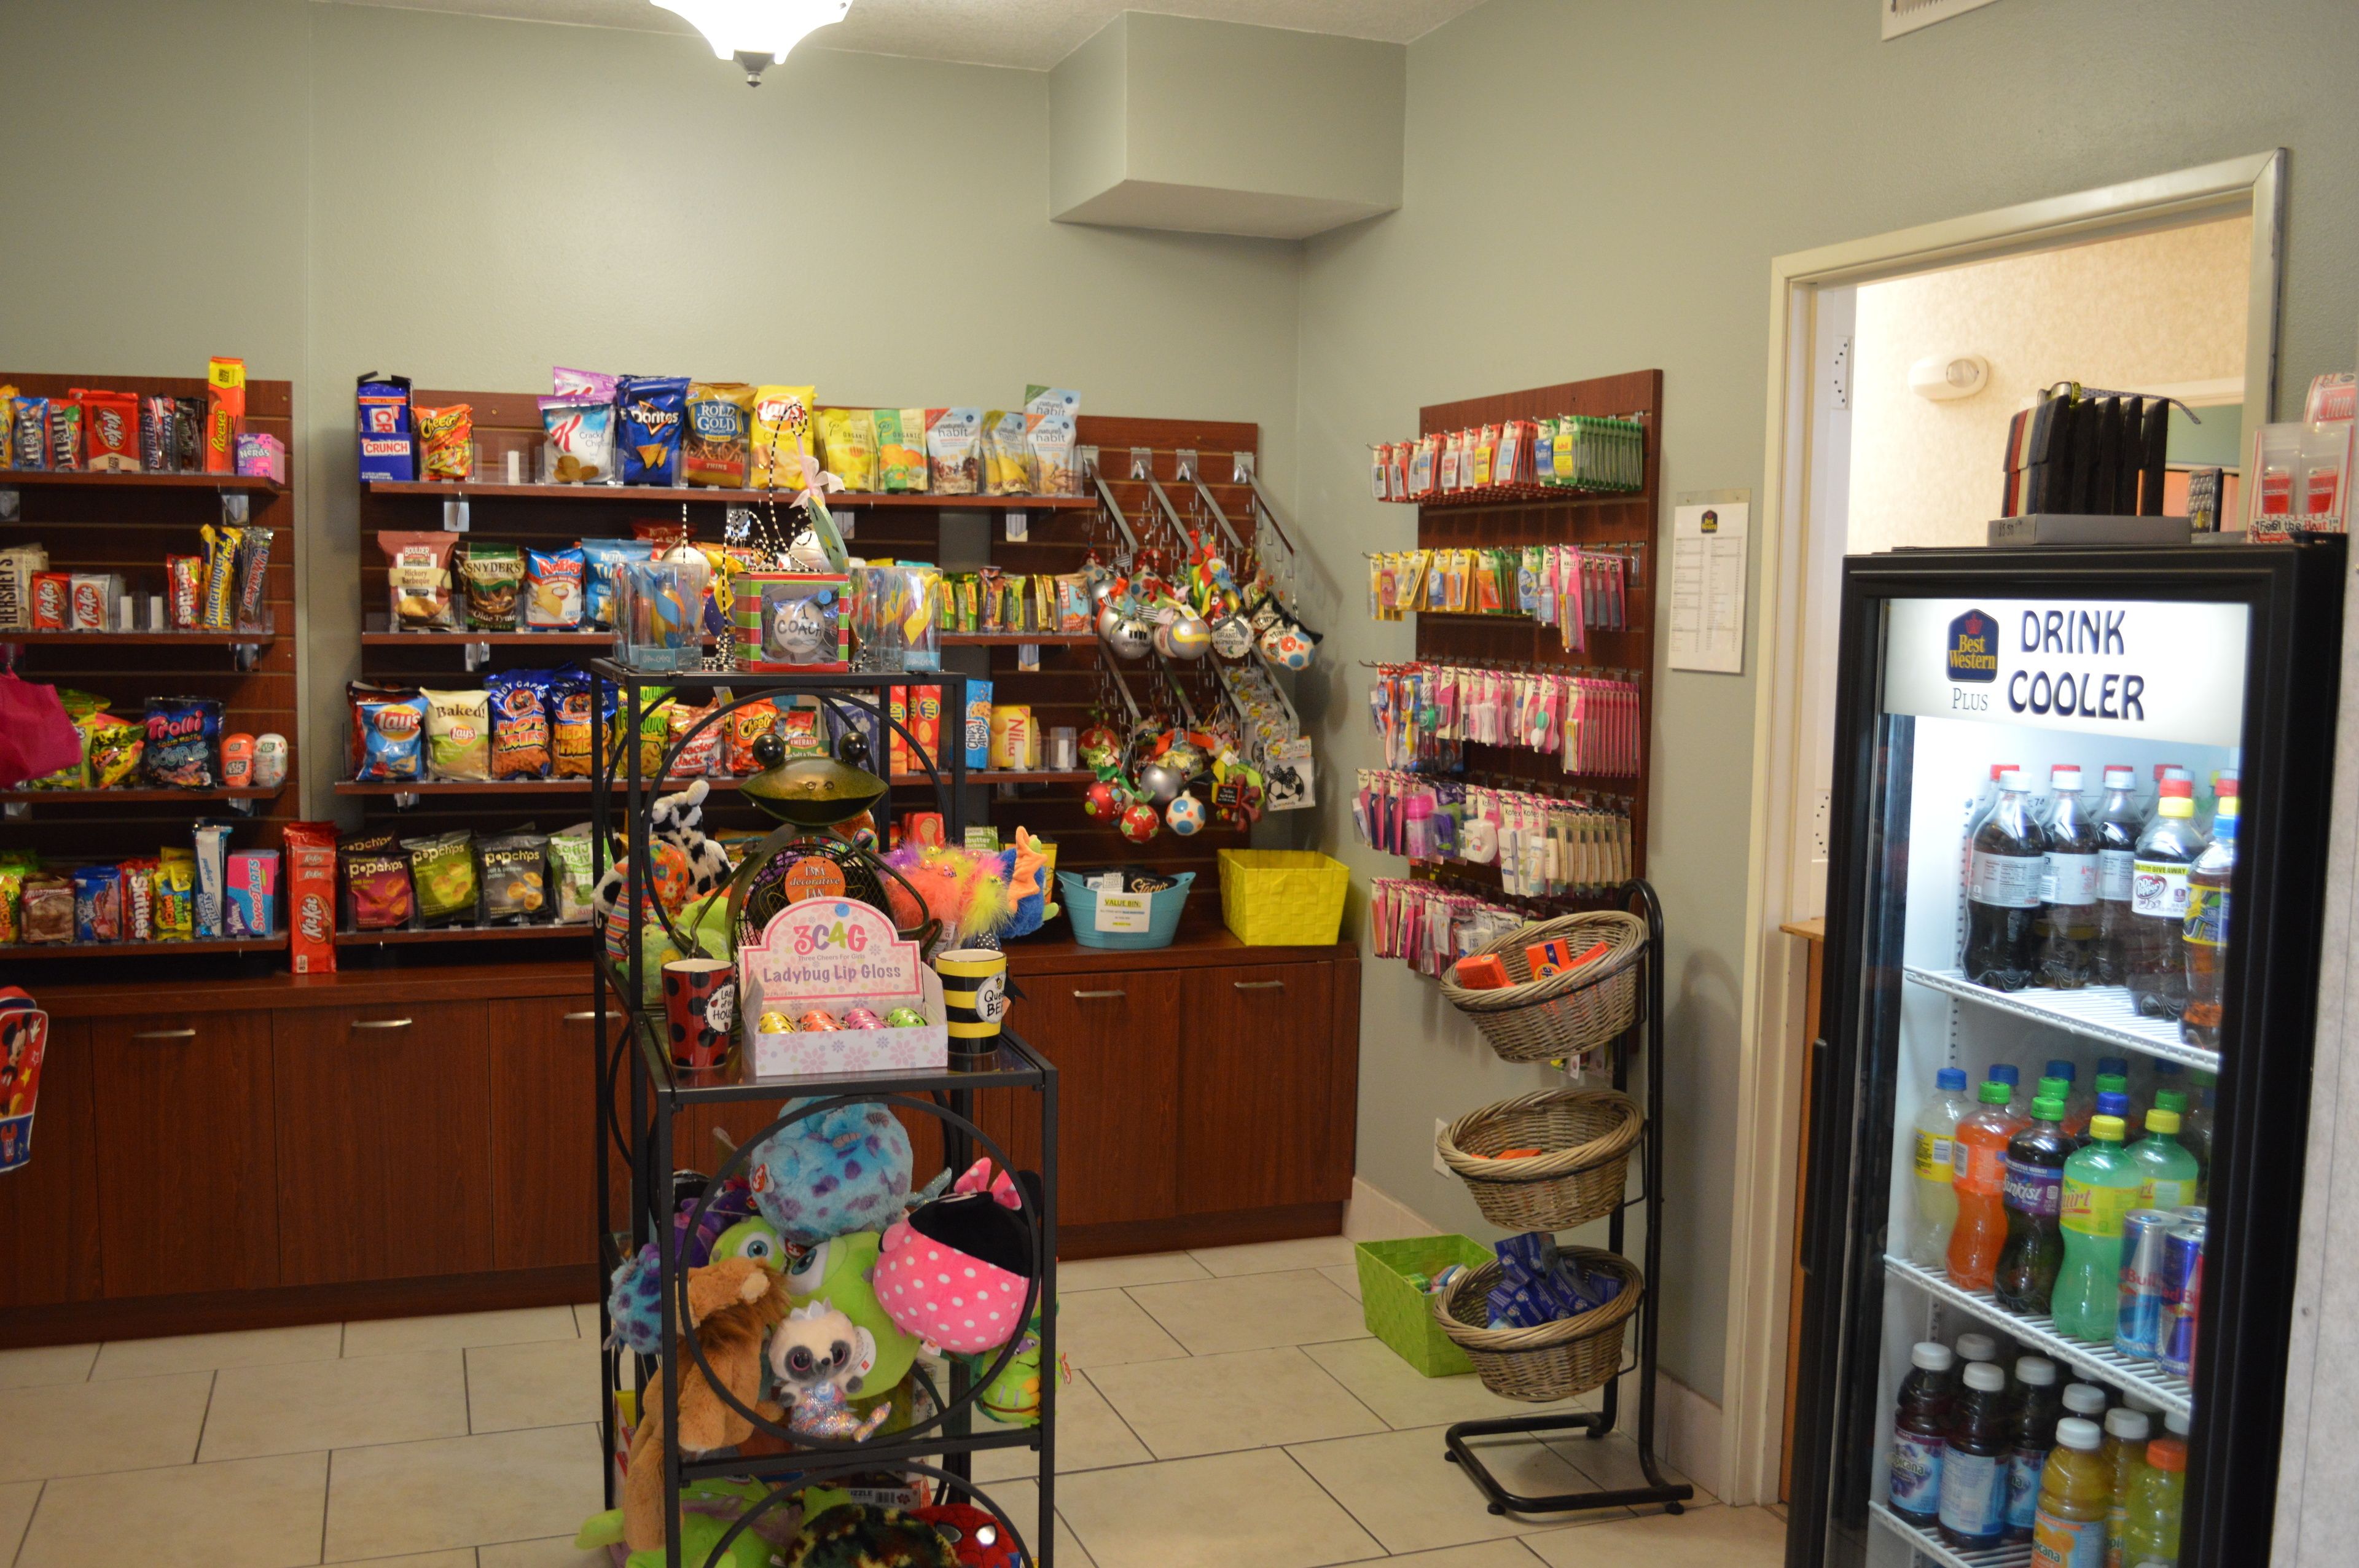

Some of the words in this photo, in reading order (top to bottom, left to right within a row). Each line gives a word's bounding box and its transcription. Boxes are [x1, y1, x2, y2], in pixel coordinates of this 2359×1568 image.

[631, 410, 679, 424] Doritos
[700, 404, 735, 419] ROLD
[552, 414, 582, 453] K
[697, 417, 737, 432] GOLD
[937, 427, 969, 438] habit
[1035, 432, 1066, 443] habit
[365, 442, 409, 454] CRUNCH
[404, 546, 431, 557] BOULDER
[404, 569, 428, 579] Hickory
[466, 561, 522, 574] SNYDER'S
[242, 560, 267, 608] Musketeers
[402, 577, 431, 586] Barbeque
[174, 563, 192, 625] Skittles
[203, 555, 227, 628] Butterfinger
[777, 620, 822, 638] COACH
[2020, 610, 2126, 655] DRINK
[1958, 634, 1985, 653] Best
[1948, 649, 1996, 671] Western
[493, 681, 513, 703] ANDY
[516, 681, 547, 699] CAPP'S
[2007, 669, 2145, 721] COOLER
[436, 704, 485, 719] Baked!
[923, 698, 936, 719] RITZ
[146, 709, 205, 739] Trolli
[498, 716, 544, 736] HOT
[966, 725, 978, 750] Chips
[977, 721, 988, 747] Ahoy!
[412, 844, 464, 865] popchips
[485, 850, 540, 867] popchips
[349, 860, 403, 878] popchips
[805, 867, 815, 876] I'M
[817, 867, 826, 876] A
[789, 877, 841, 886] decorative
[2137, 881, 2163, 897] Pepper
[805, 887, 826, 899] FAN
[130, 876, 151, 939] Skittles
[162, 895, 175, 926] PATCH
[173, 895, 184, 924] SOUR
[301, 897, 323, 938] KitKat
[794, 921, 868, 956] 3C4G
[764, 965, 831, 983] Ladybug
[834, 964, 857, 981] Lip
[861, 964, 901, 980] Gloss
